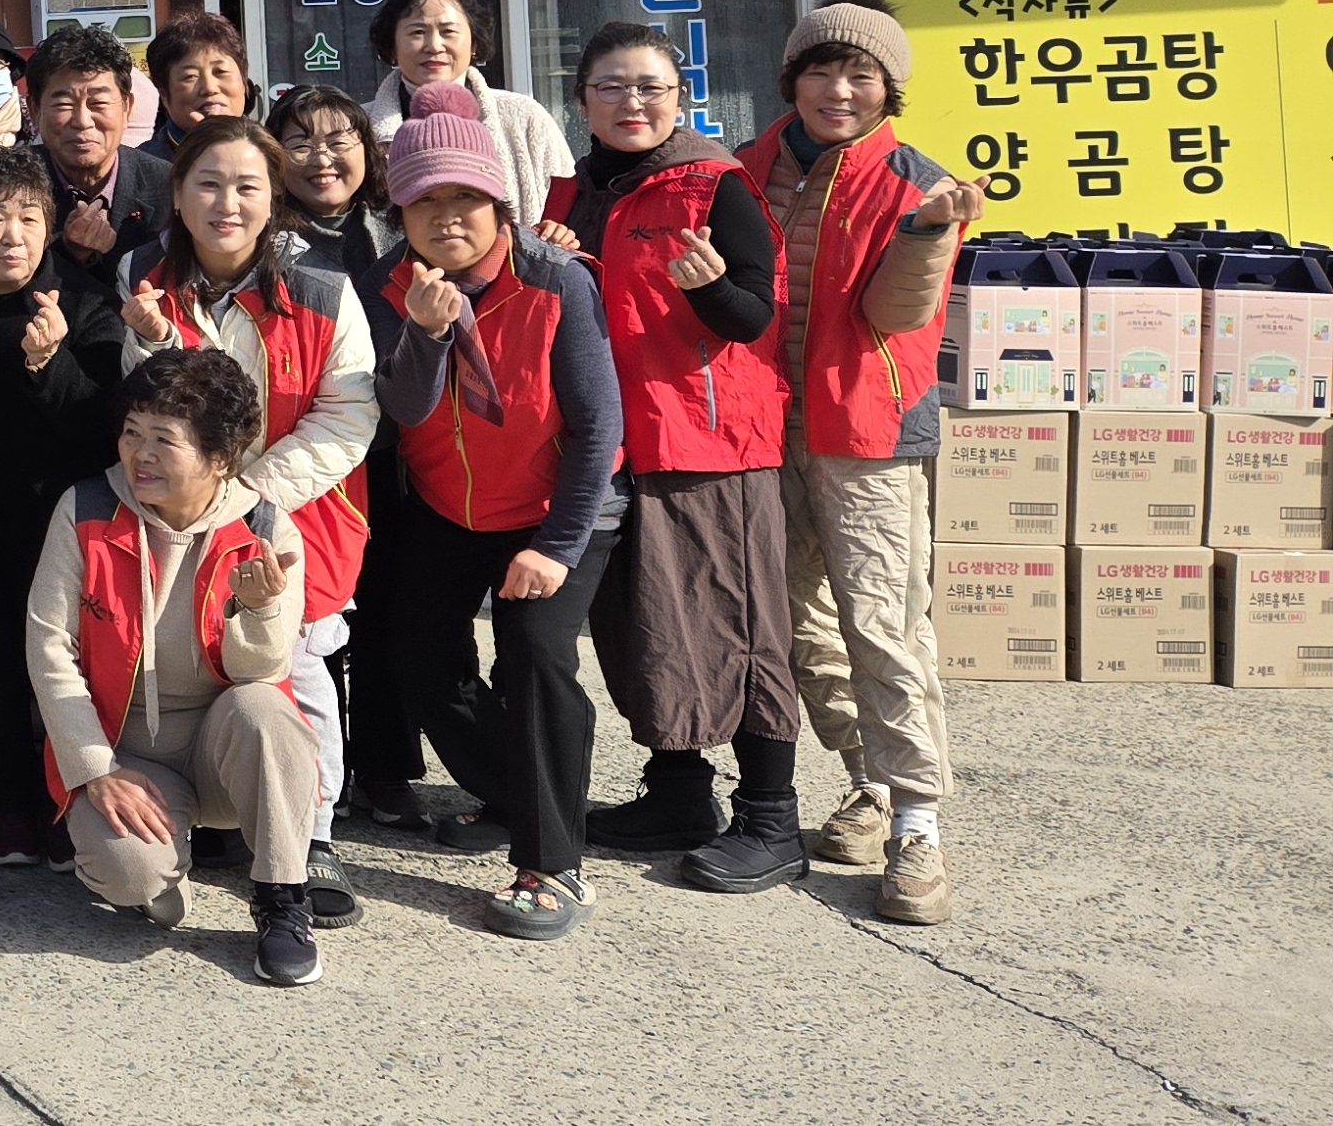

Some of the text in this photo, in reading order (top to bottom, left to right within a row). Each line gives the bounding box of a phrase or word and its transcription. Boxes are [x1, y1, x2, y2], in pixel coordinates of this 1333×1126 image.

[959, 31, 1224, 106] 한우곰탕
[951, 447, 1017, 464] 스위트홈 베스트
[1092, 450, 1156, 466] 스위트홈 베스트
[1225, 452, 1288, 469] 스위트홈 베스트
[950, 520, 979, 531] 2 세트
[1090, 523, 1118, 534] 2 세트
[1223, 525, 1251, 536] 2 세트
[947, 584, 1014, 600] 스위트홈 베스트
[1096, 587, 1163, 603] 스위트홈 베스트
[1249, 592, 1305, 609] 스위트홈 베스트
[947, 657, 976, 668] 2 세트
[1097, 661, 1126, 671] 2 세트
[1248, 666, 1275, 677] 2 세트
